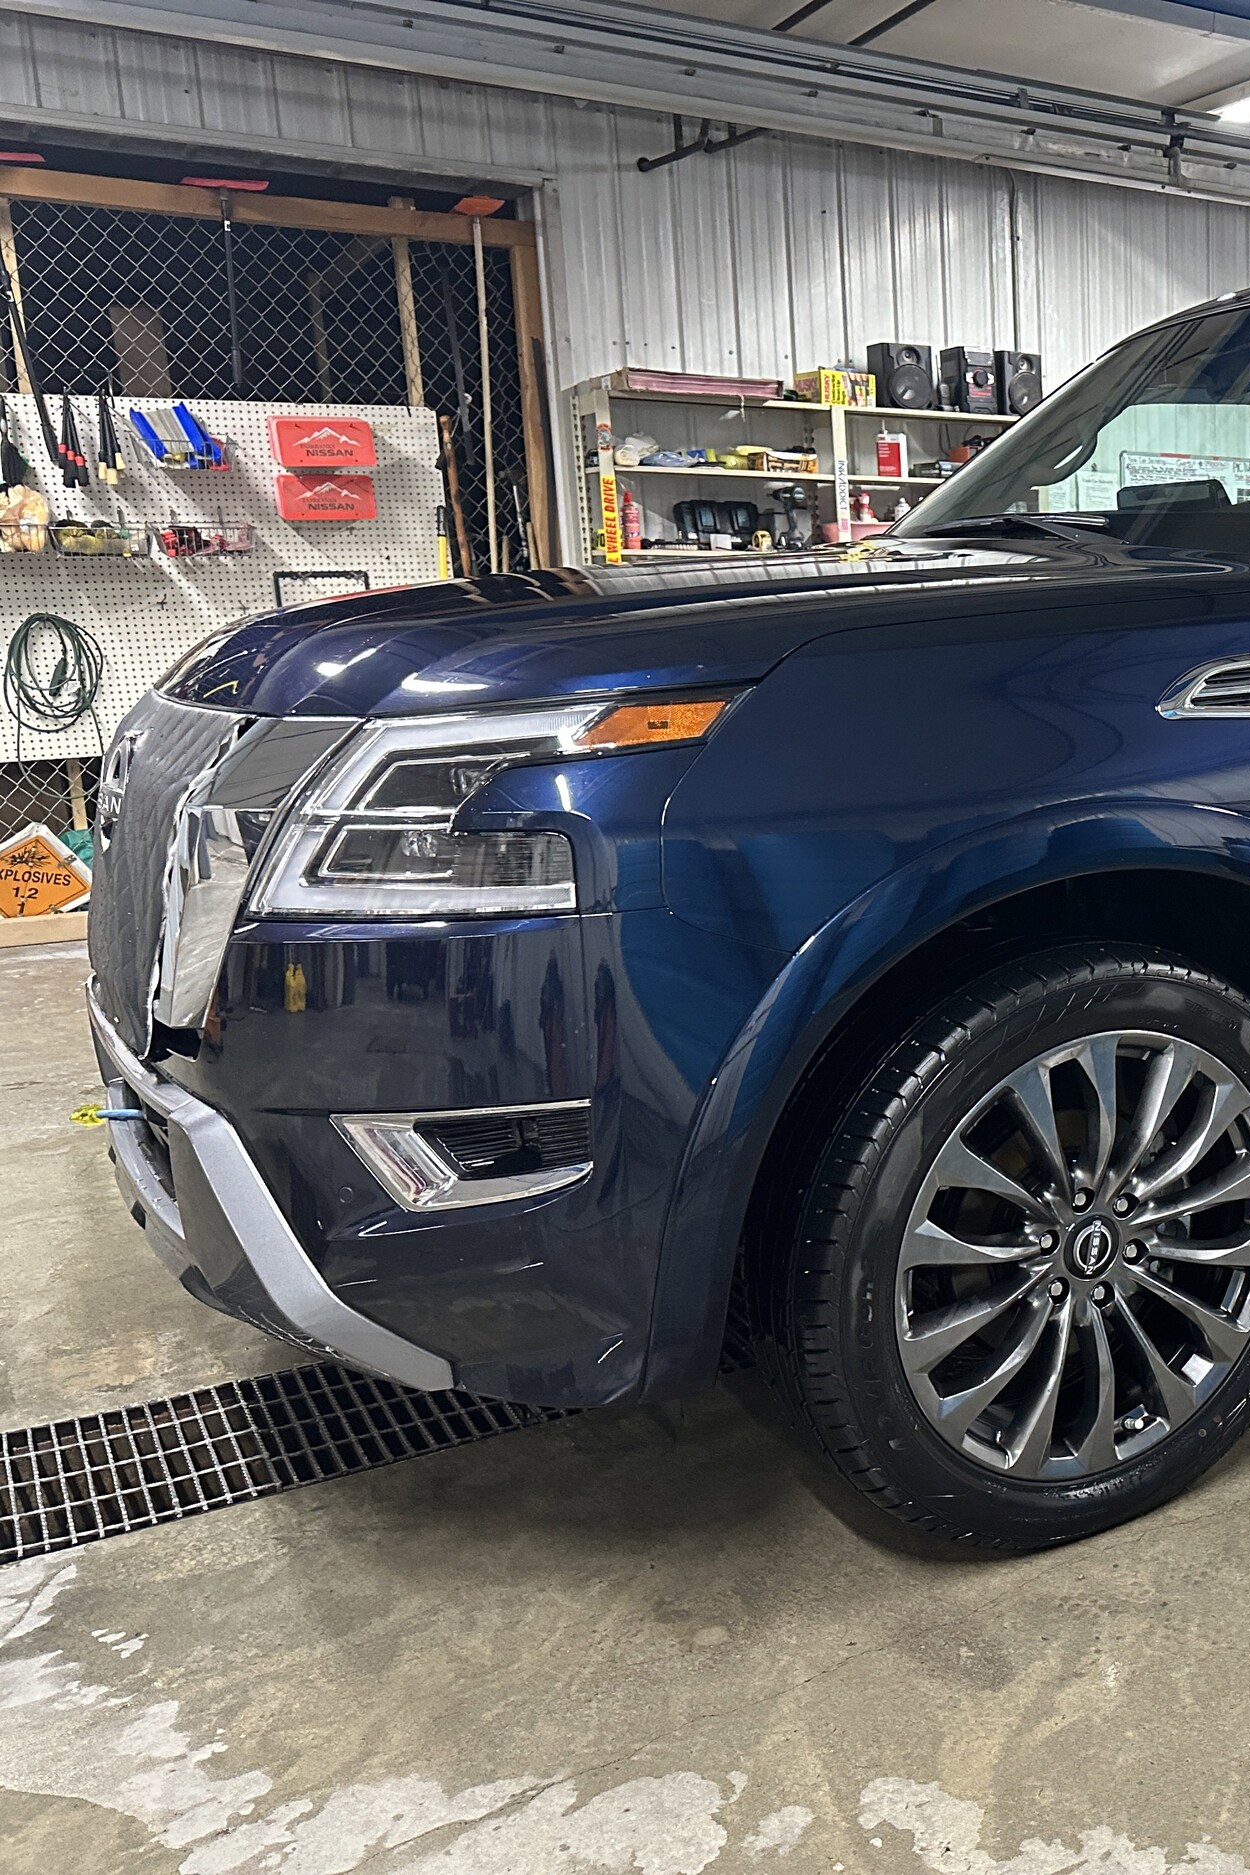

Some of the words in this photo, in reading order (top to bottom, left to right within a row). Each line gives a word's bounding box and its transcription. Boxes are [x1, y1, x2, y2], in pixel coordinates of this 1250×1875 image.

[823, 373, 831, 403] HUSKY
[305, 449, 354, 457] NISSAN
[307, 503, 355, 511] NISSAN
[602, 477, 615, 513] DRIVE
[605, 516, 618, 553] WHEEL
[1086, 1222, 1102, 1275] NISSAN
